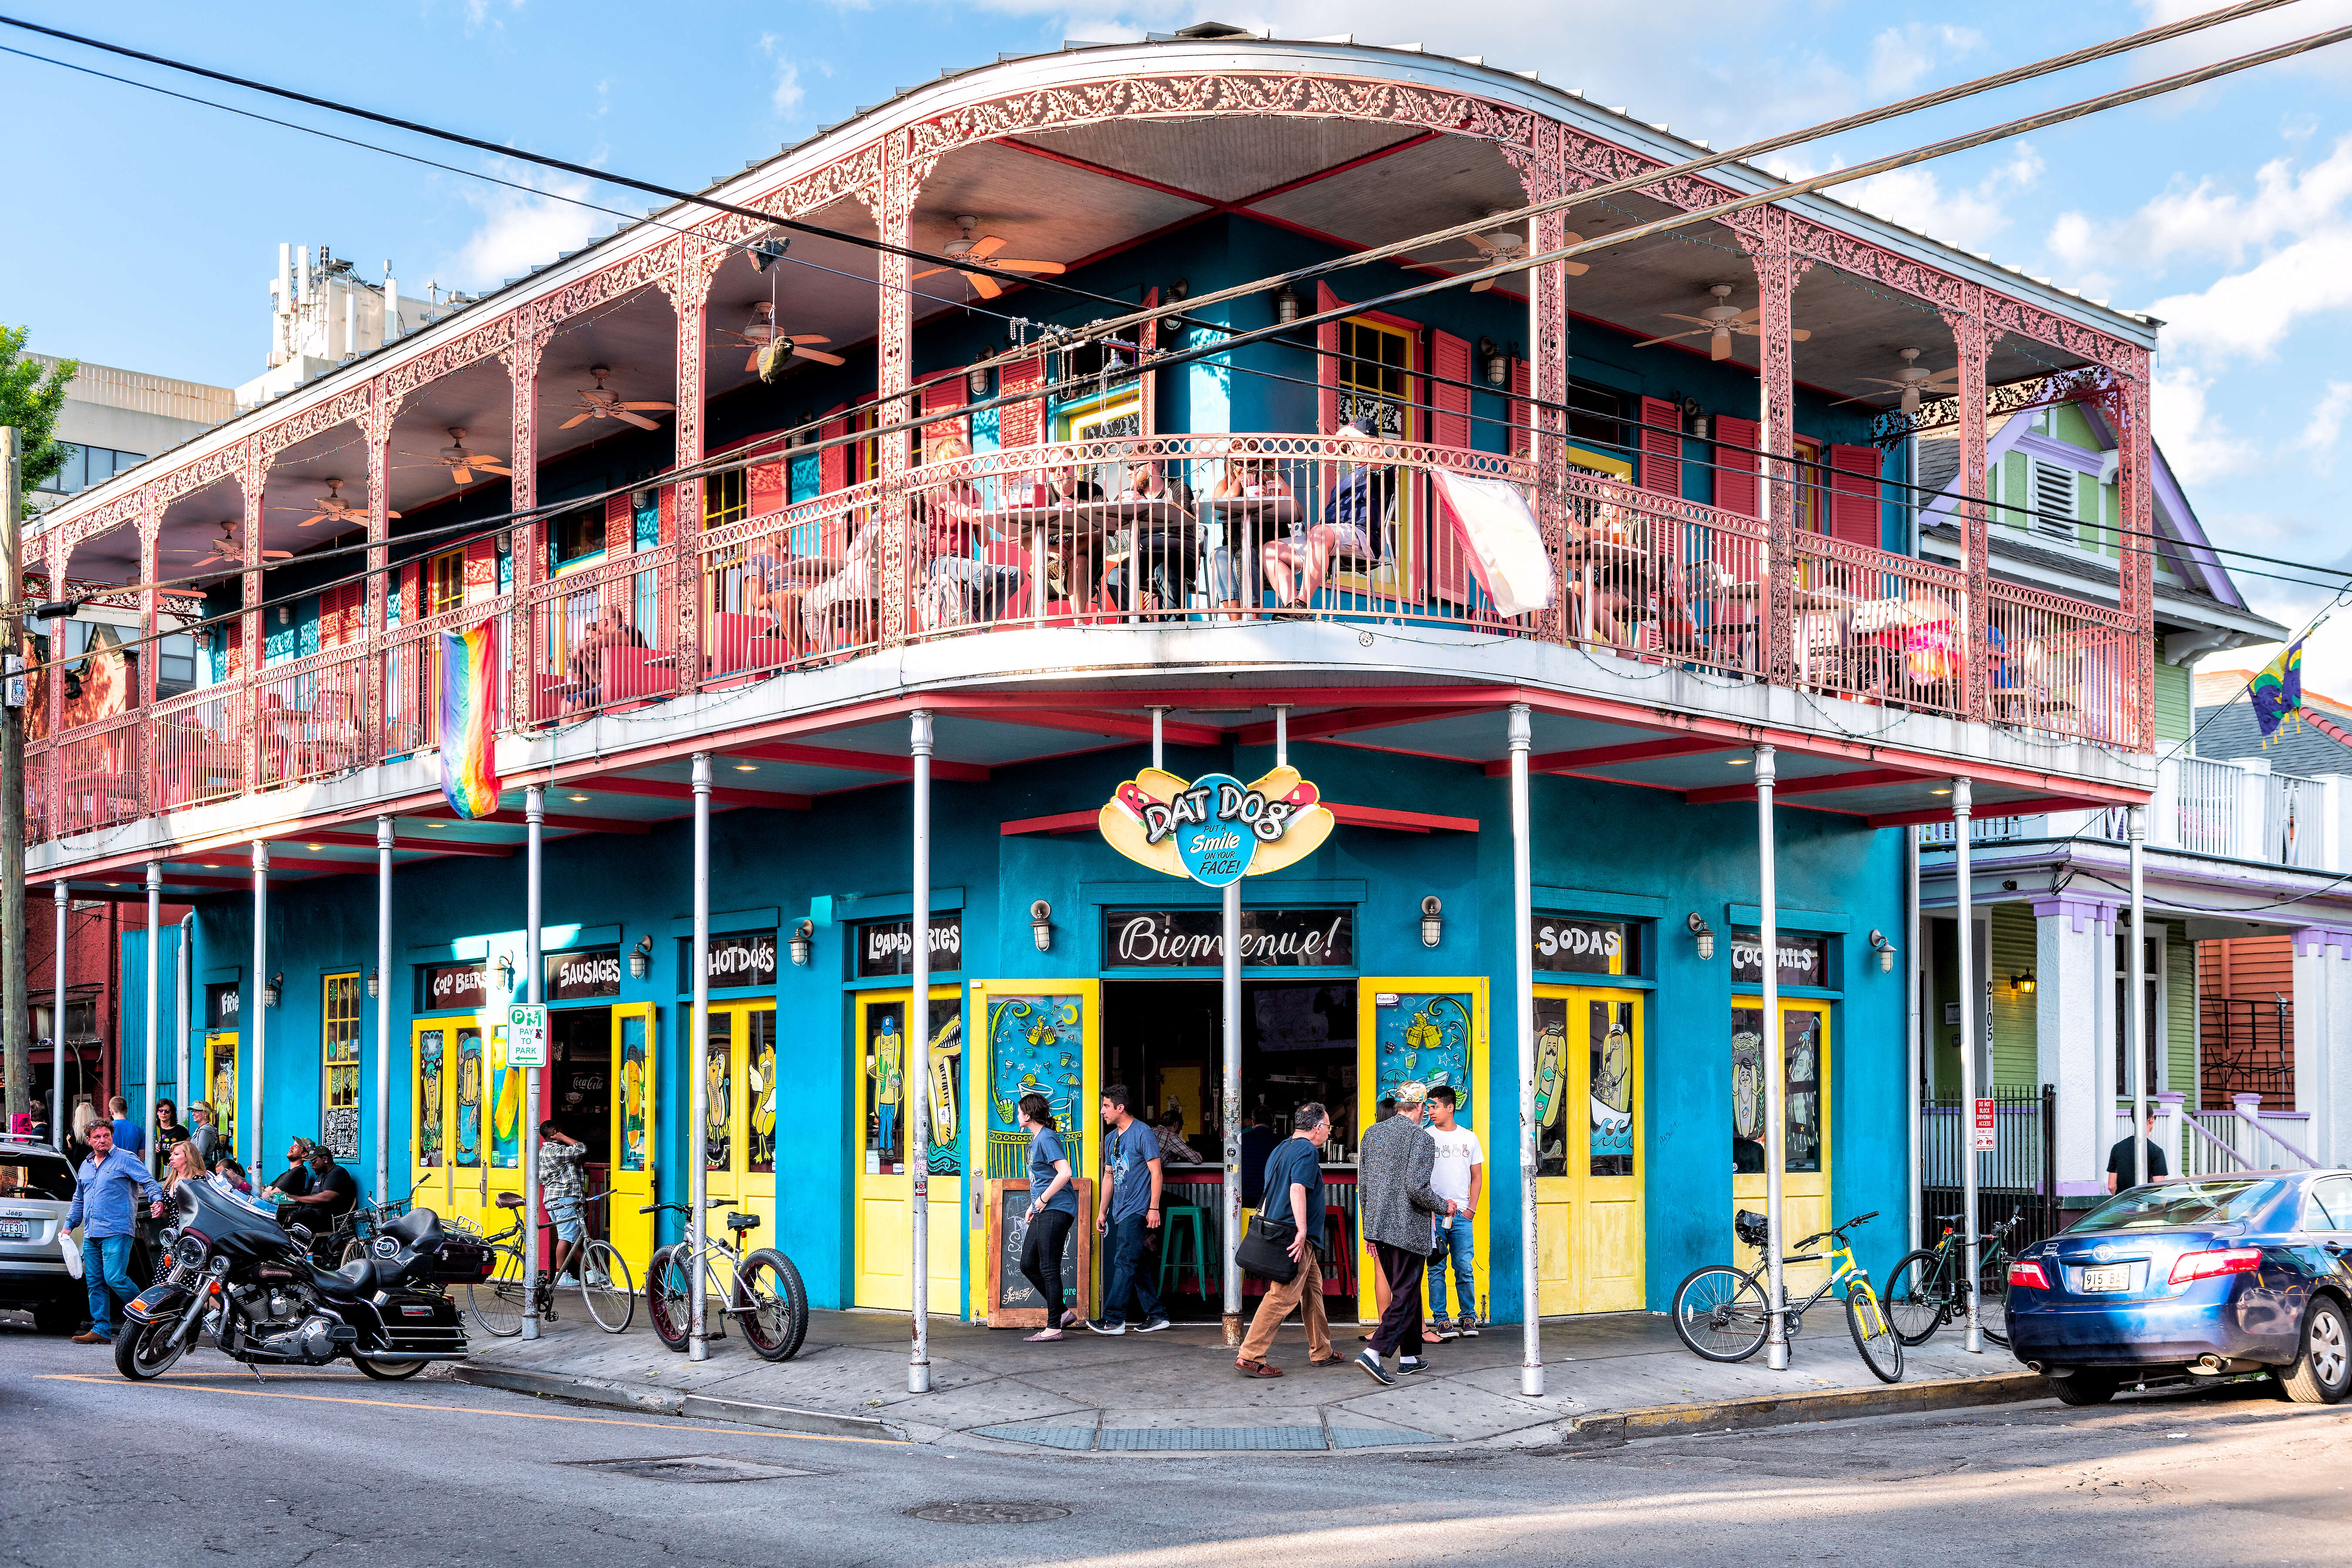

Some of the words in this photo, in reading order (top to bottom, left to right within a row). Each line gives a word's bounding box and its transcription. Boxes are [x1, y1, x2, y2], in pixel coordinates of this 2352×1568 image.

[1141, 785, 1212, 845] DAT
[1204, 825, 1220, 833] PUT
[1189, 831, 1240, 854] Smile
[1216, 851, 1235, 859] YOUR
[1198, 860, 1241, 875] FACE!
[868, 933, 912, 960] LOADED
[1119, 917, 1342, 960] Bienenue!
[1540, 926, 1621, 956] SODAS
[560, 959, 620, 987] SAUSAGES
[708, 946, 738, 976] HOT
[433, 974, 453, 996] COLD
[456, 971, 487, 994] BEERS
[0, 1223, 27, 1233] ZFE301
[2087, 1274, 2103, 1285] 915
